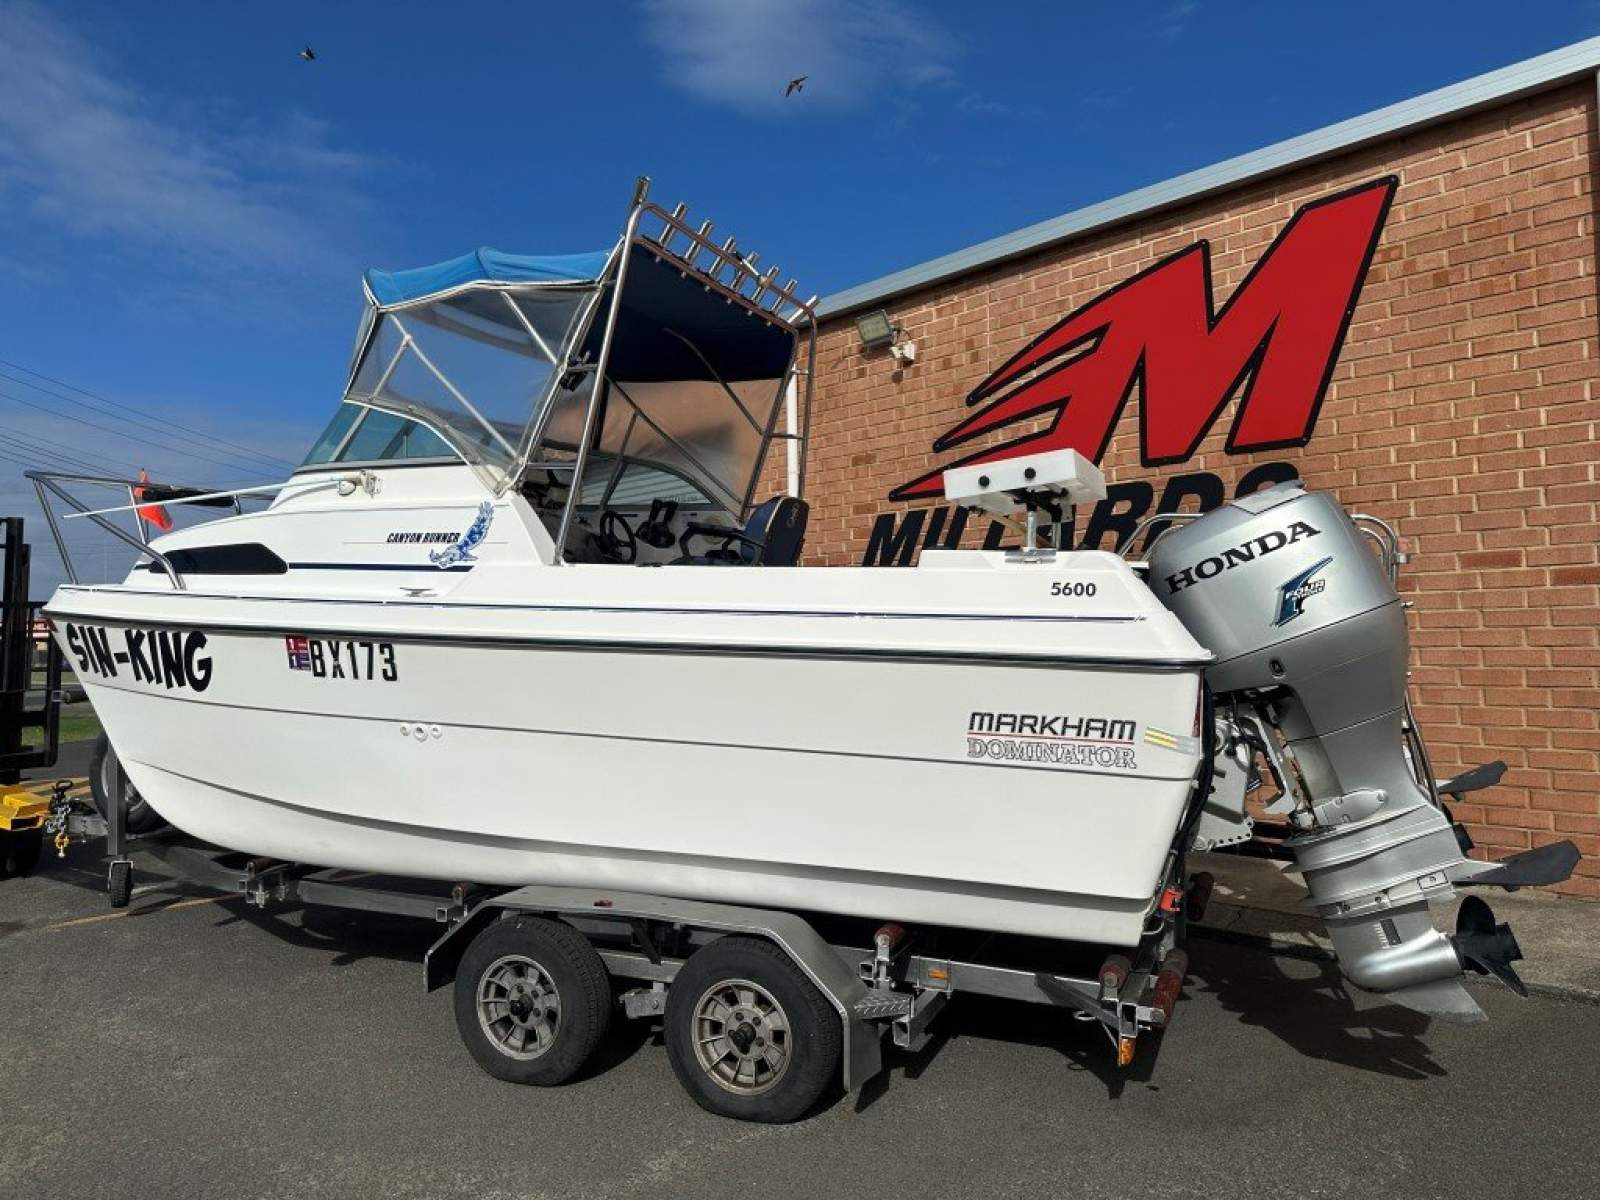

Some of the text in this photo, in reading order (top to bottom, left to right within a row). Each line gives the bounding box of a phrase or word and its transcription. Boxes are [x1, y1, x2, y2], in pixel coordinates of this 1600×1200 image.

[386, 532, 461, 543] CANYON RUNNER
[1165, 521, 1322, 594] HONDA
[1051, 582, 1097, 597] 5600
[66, 622, 213, 692] SIN-KING
[309, 639, 398, 682] BX173
[968, 711, 1137, 740] MARKHAM
[966, 737, 1138, 769] DOMINATOR
